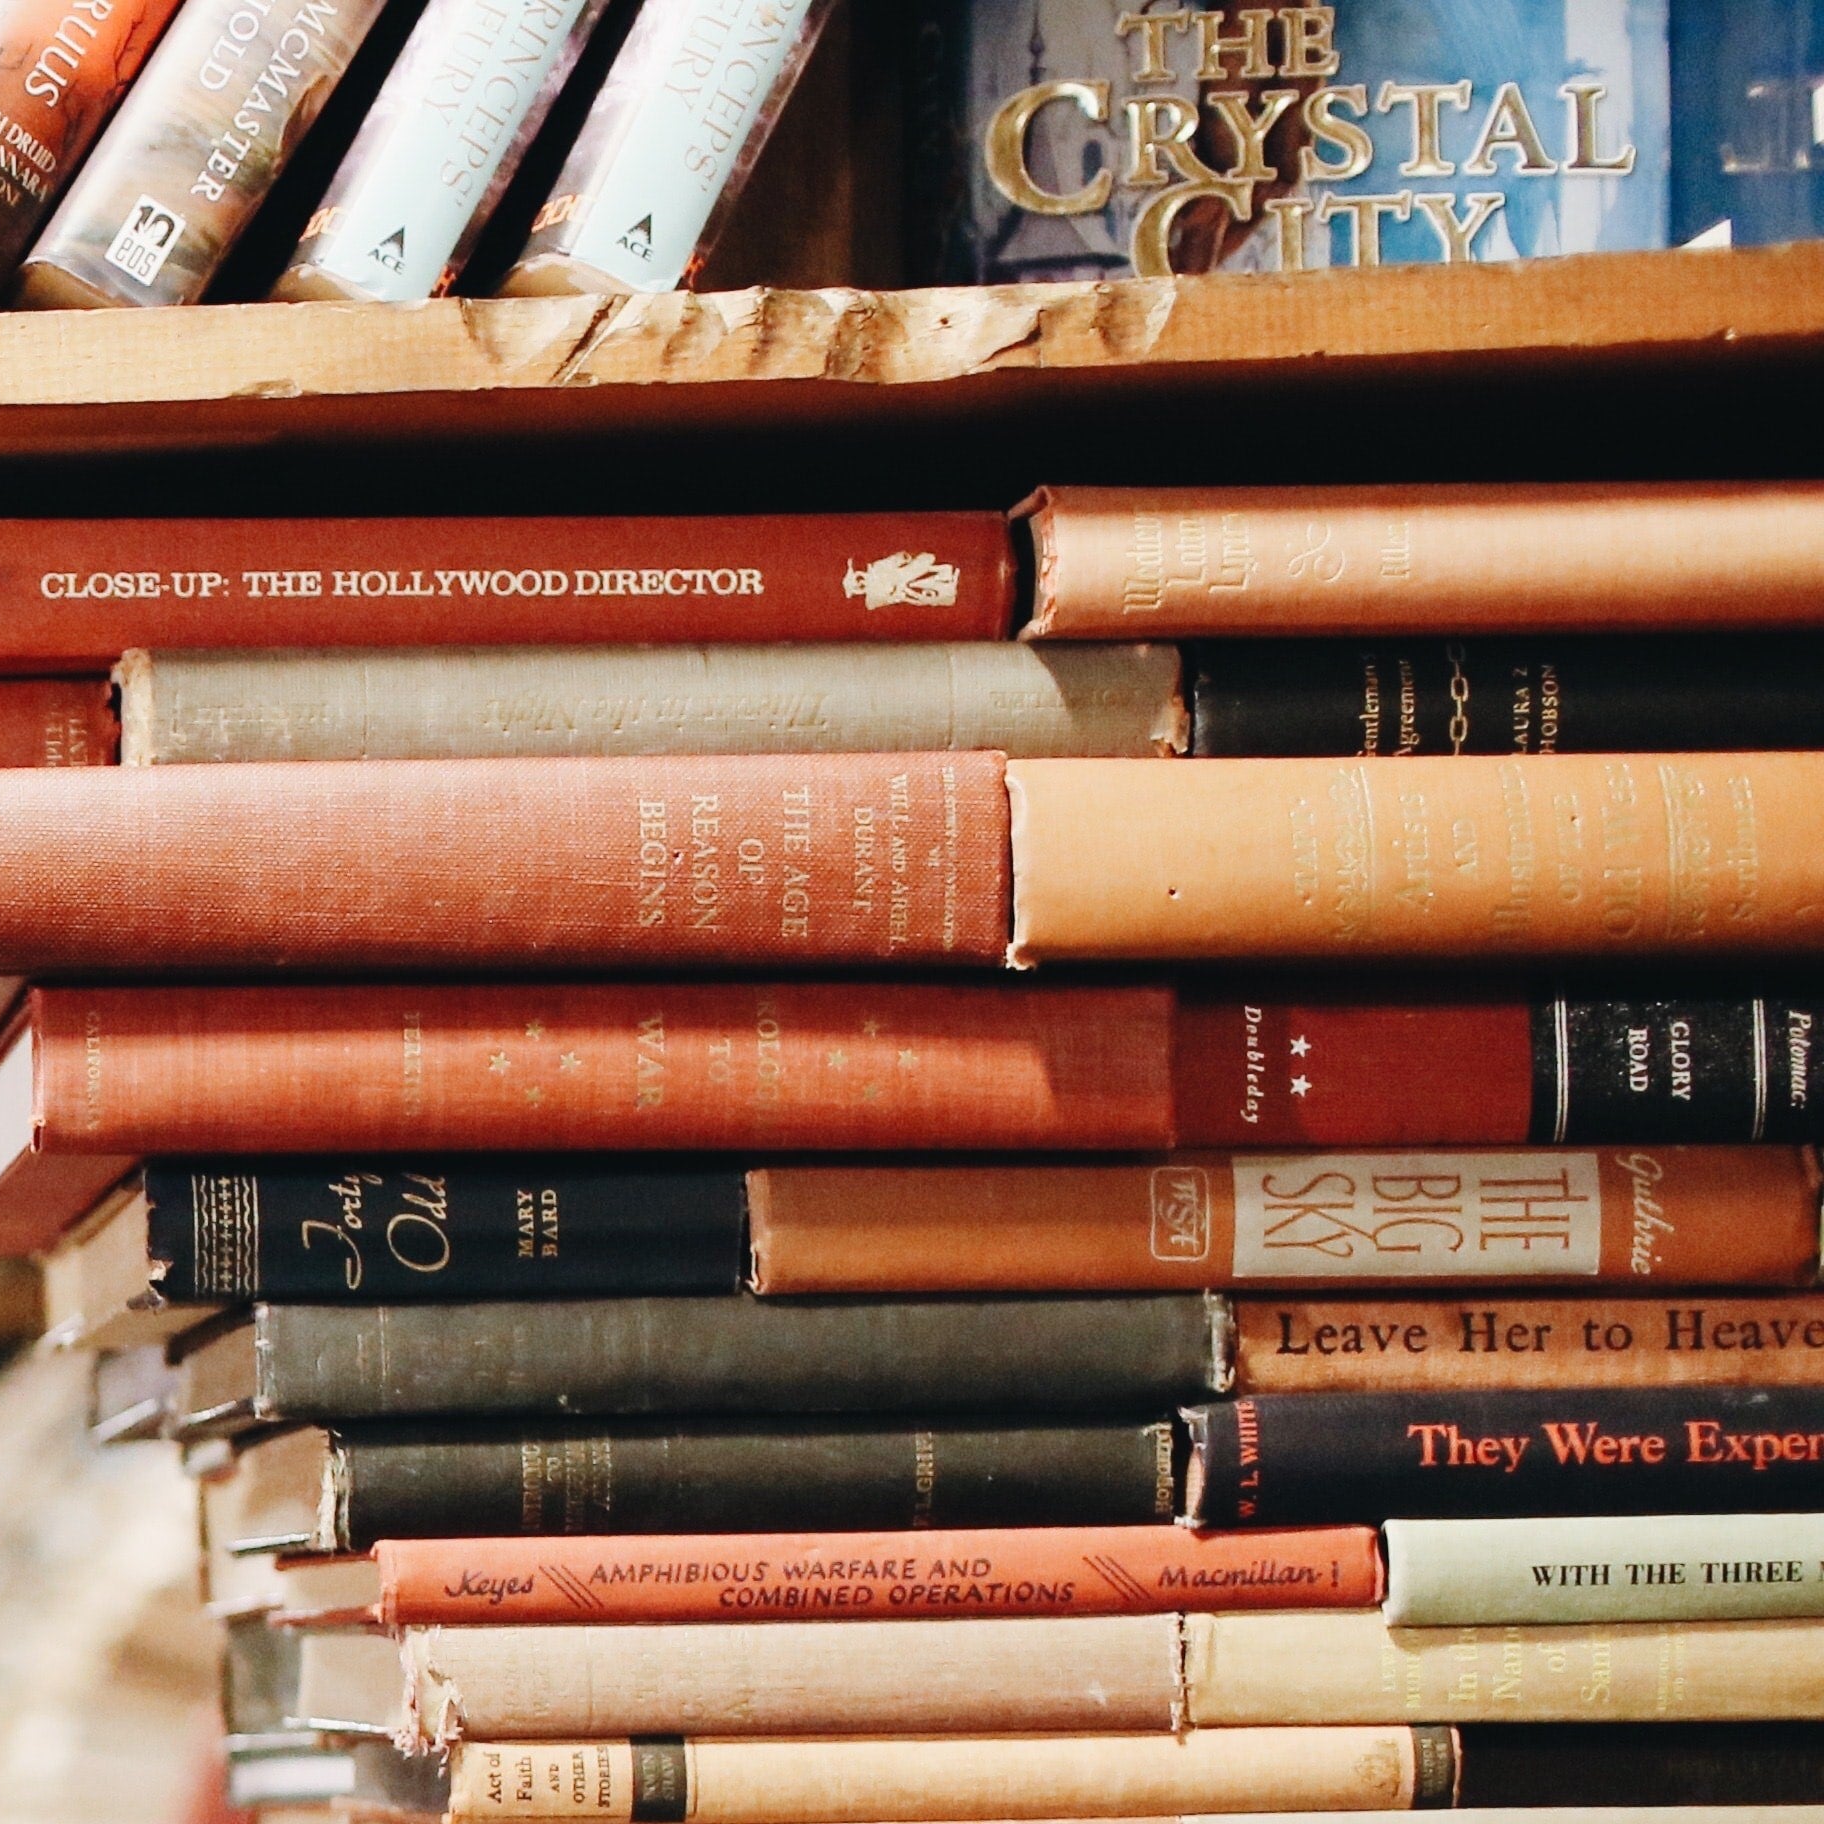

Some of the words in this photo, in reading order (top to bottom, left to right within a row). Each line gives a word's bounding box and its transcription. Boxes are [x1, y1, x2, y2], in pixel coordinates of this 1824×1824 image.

[1116, 8, 1339, 81] THE
[3, 123, 58, 174] DRUID
[985, 78, 1635, 216] CRYSTAL
[368, 246, 405, 274] ACE
[616, 232, 653, 261] ACE
[39, 569, 229, 600] CLOSE-UP:
[244, 569, 323, 598] THE
[334, 567, 568, 600] HOLLYWOOD
[576, 566, 765, 598] DIRECTOR
[782, 786, 809, 852] THE
[639, 799, 664, 926] BEGINS
[692, 794, 718, 932] REASON
[737, 836, 764, 889] OF
[853, 808, 873, 911] DURANT
[782, 869, 809, 939] AGE
[1241, 1007, 1263, 1124] Doubleday
[1627, 1028, 1648, 1093] ROAD
[1671, 1022, 1690, 1101] GLORY
[517, 1188, 532, 1258] MARY
[543, 1188, 558, 1258] BARD
[1262, 1171, 1355, 1260] SKY
[1372, 1171, 1462, 1254] BIG
[1480, 1169, 1569, 1251] THE
[1615, 1152, 1666, 1276] Guthrie
[1277, 1313, 1427, 1355] Leave
[1459, 1313, 1551, 1353] Her
[1582, 1320, 1633, 1352] to
[1407, 1422, 1529, 1471] They
[1543, 1422, 1664, 1466] Were
[445, 1569, 536, 1605] Keyes
[589, 1561, 768, 1588] AMPHIBIOUS
[779, 1560, 918, 1582] WARFARE
[929, 1557, 992, 1580] AND
[718, 1583, 864, 1608] COMBINED
[873, 1580, 1075, 1604] OPERATIONS
[1157, 1563, 1321, 1593] Macmillan
[1531, 1563, 1615, 1586] WITH
[1625, 1562, 1690, 1585] THE
[1702, 1560, 1807, 1585] THREE
